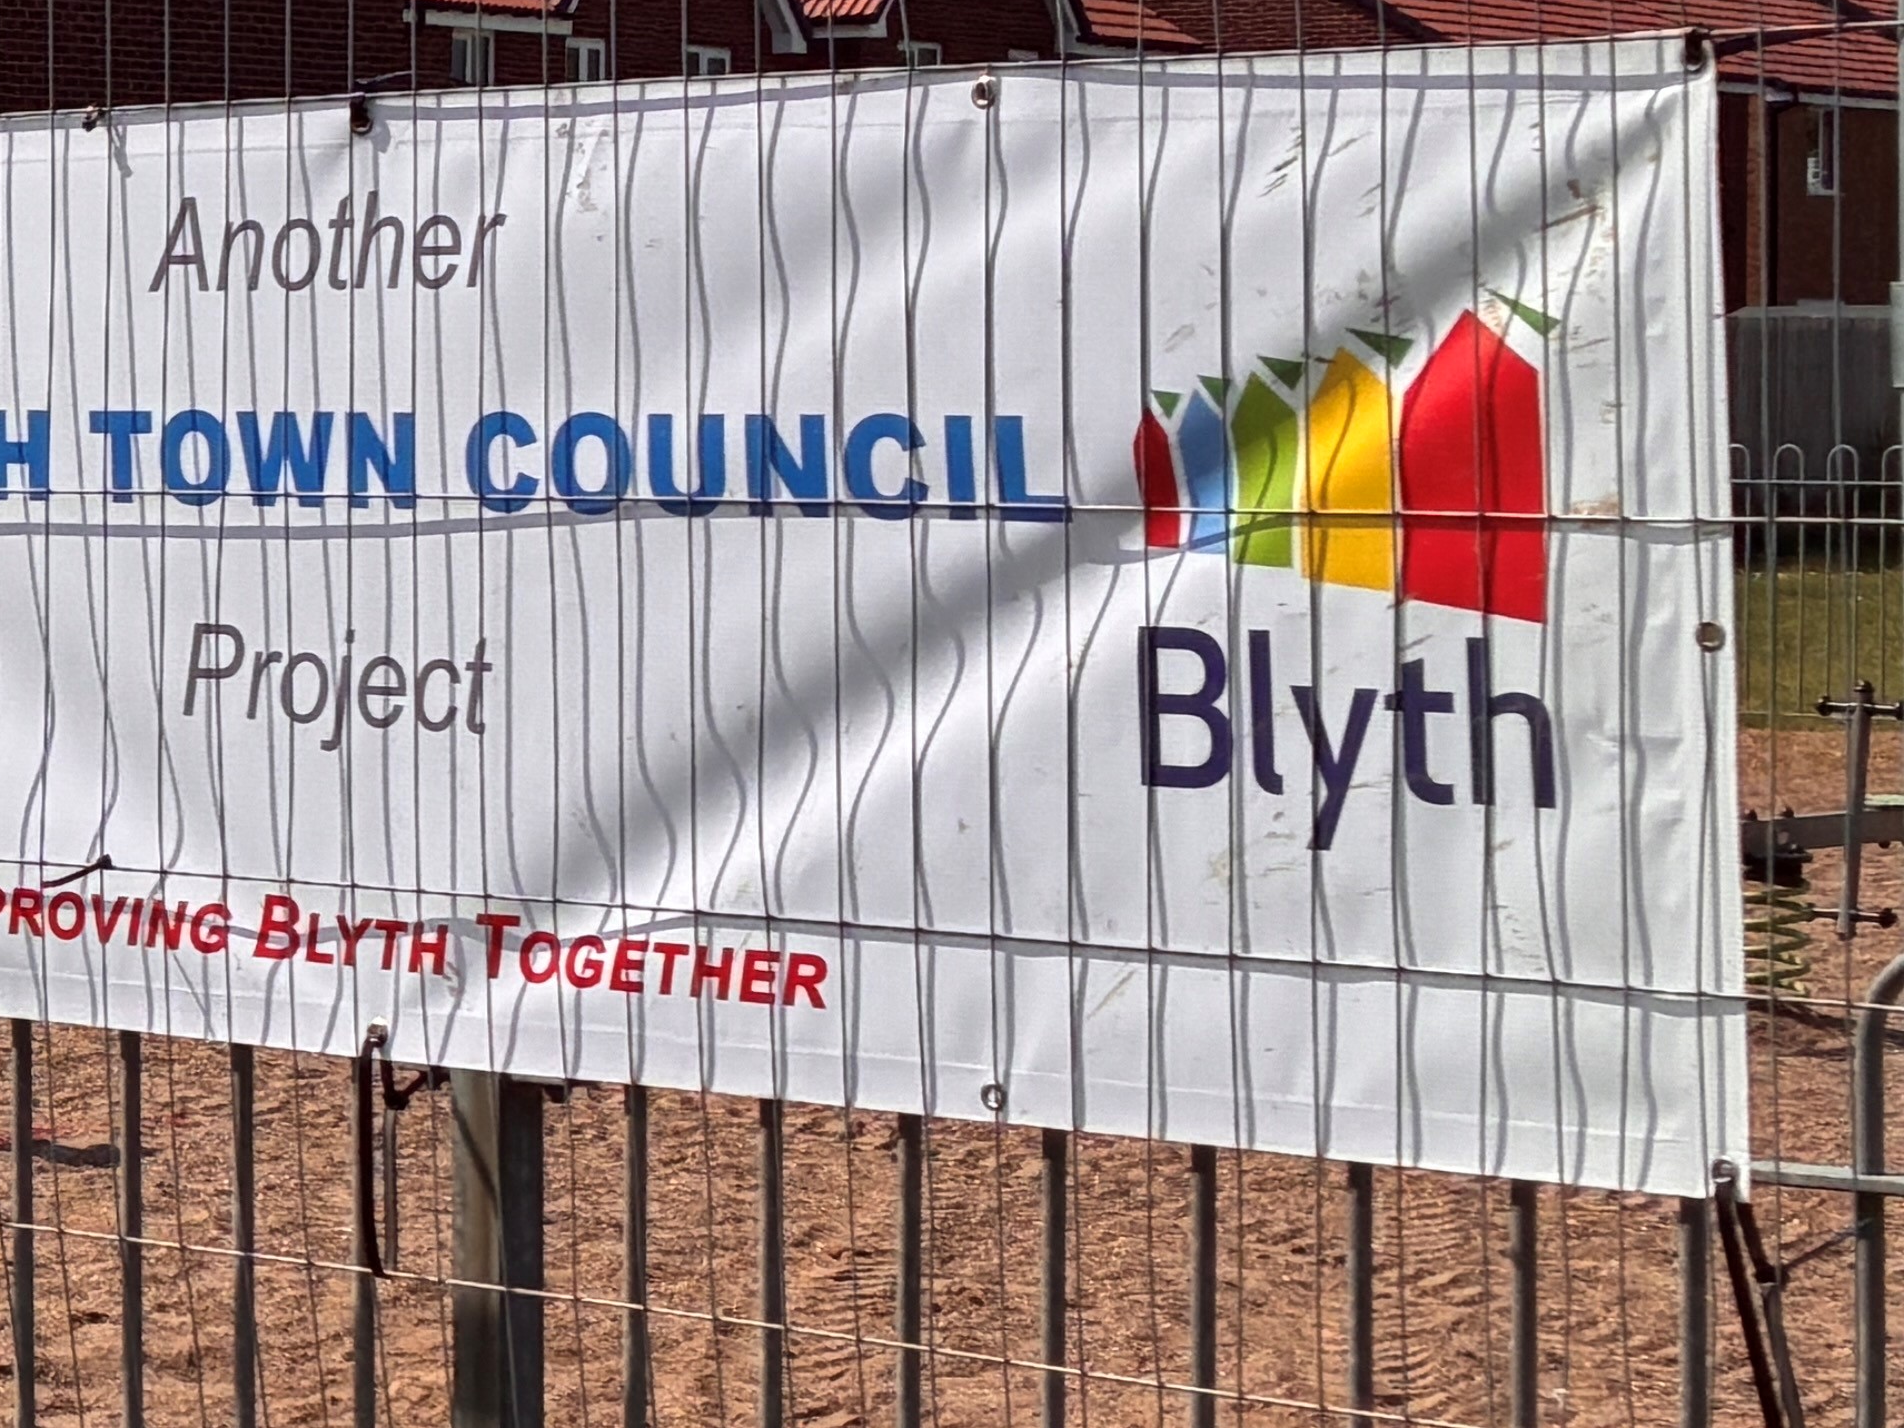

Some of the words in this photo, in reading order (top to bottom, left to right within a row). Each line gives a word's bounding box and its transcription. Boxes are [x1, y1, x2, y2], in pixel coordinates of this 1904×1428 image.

[149, 192, 508, 296] Another
[89, 409, 416, 510] TOWN
[464, 409, 1073, 523] COUNCIL
[181, 622, 494, 752] Project
[1136, 625, 1558, 851] Blyth
[252, 893, 449, 976] BLYTH
[474, 912, 828, 1010] TOGETHER
